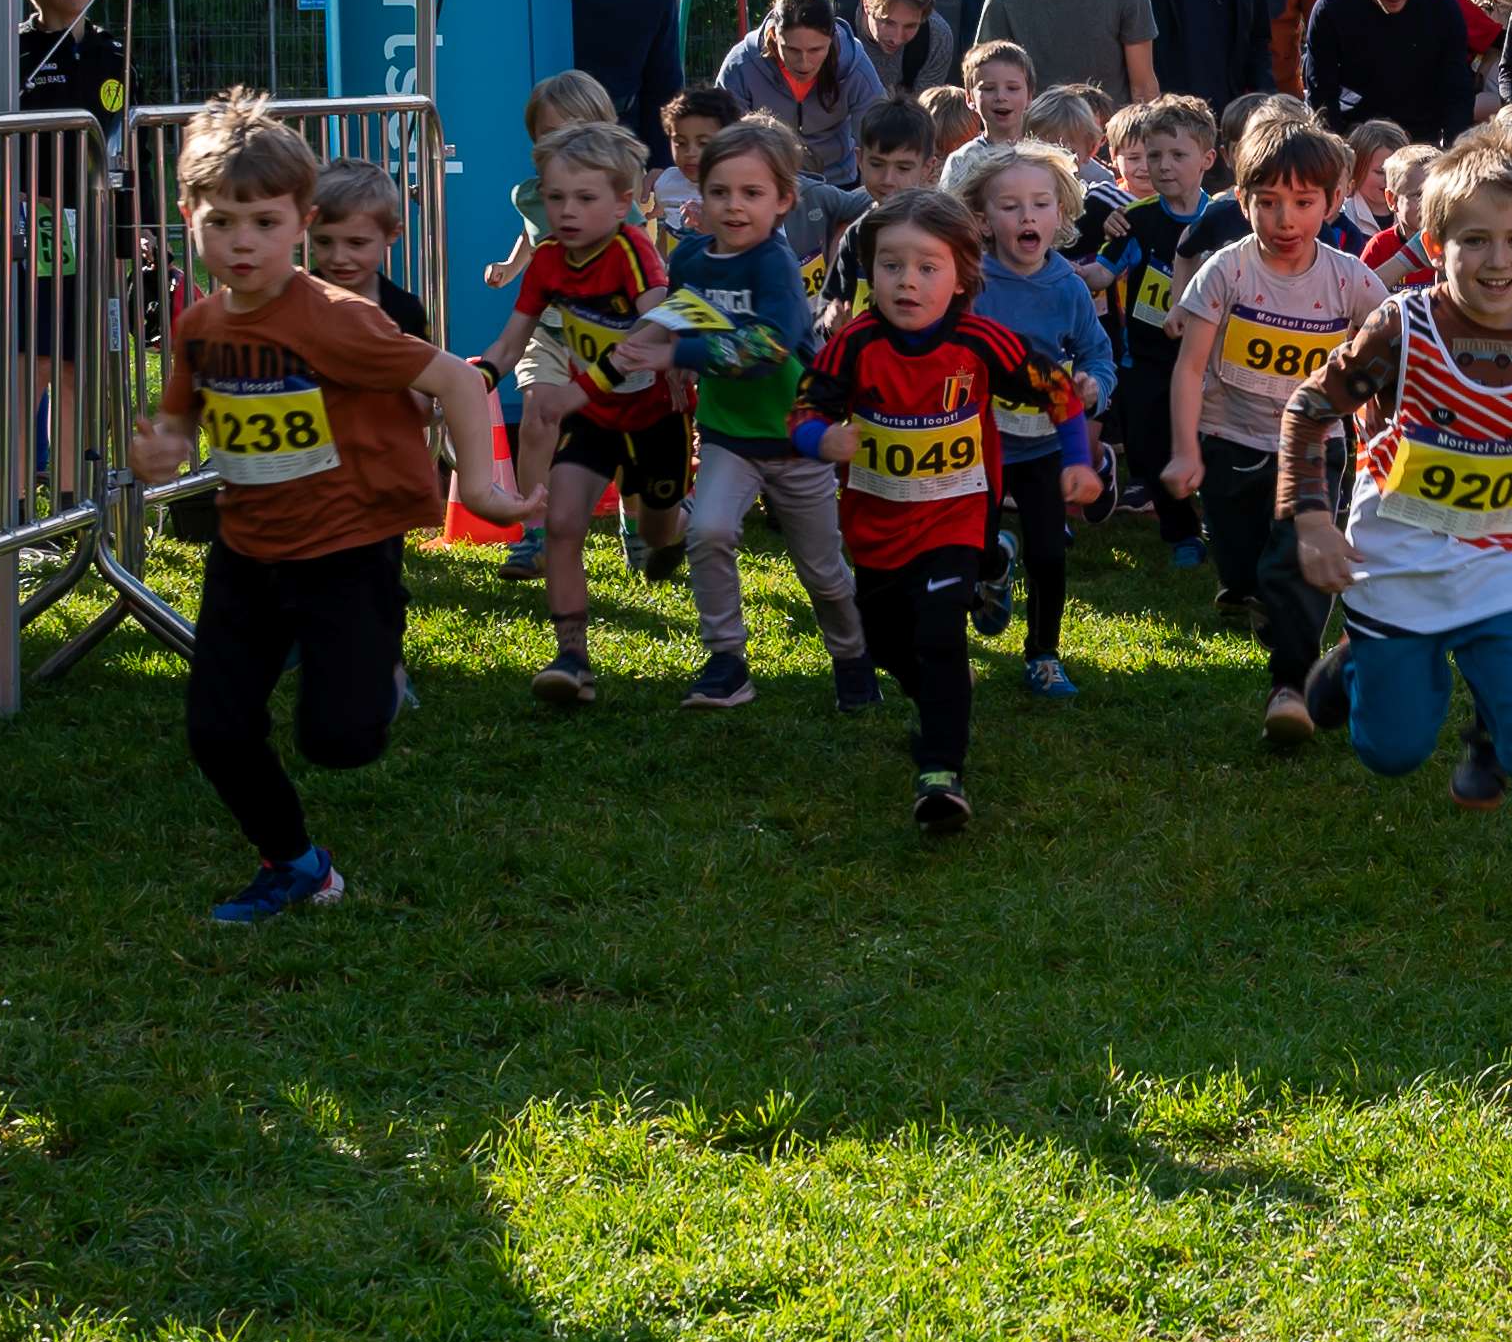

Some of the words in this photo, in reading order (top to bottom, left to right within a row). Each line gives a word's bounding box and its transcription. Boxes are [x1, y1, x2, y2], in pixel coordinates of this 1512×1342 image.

[1256, 311, 1298, 328] Mortsel
[1301, 320, 1334, 331] loopt!
[1246, 338, 1328, 378] 980
[207, 409, 319, 453] 1238
[873, 412, 918, 426] Mortsel
[923, 411, 958, 426] loopt!
[861, 436, 976, 477] 1049
[1438, 433, 1489, 453] Mortsel
